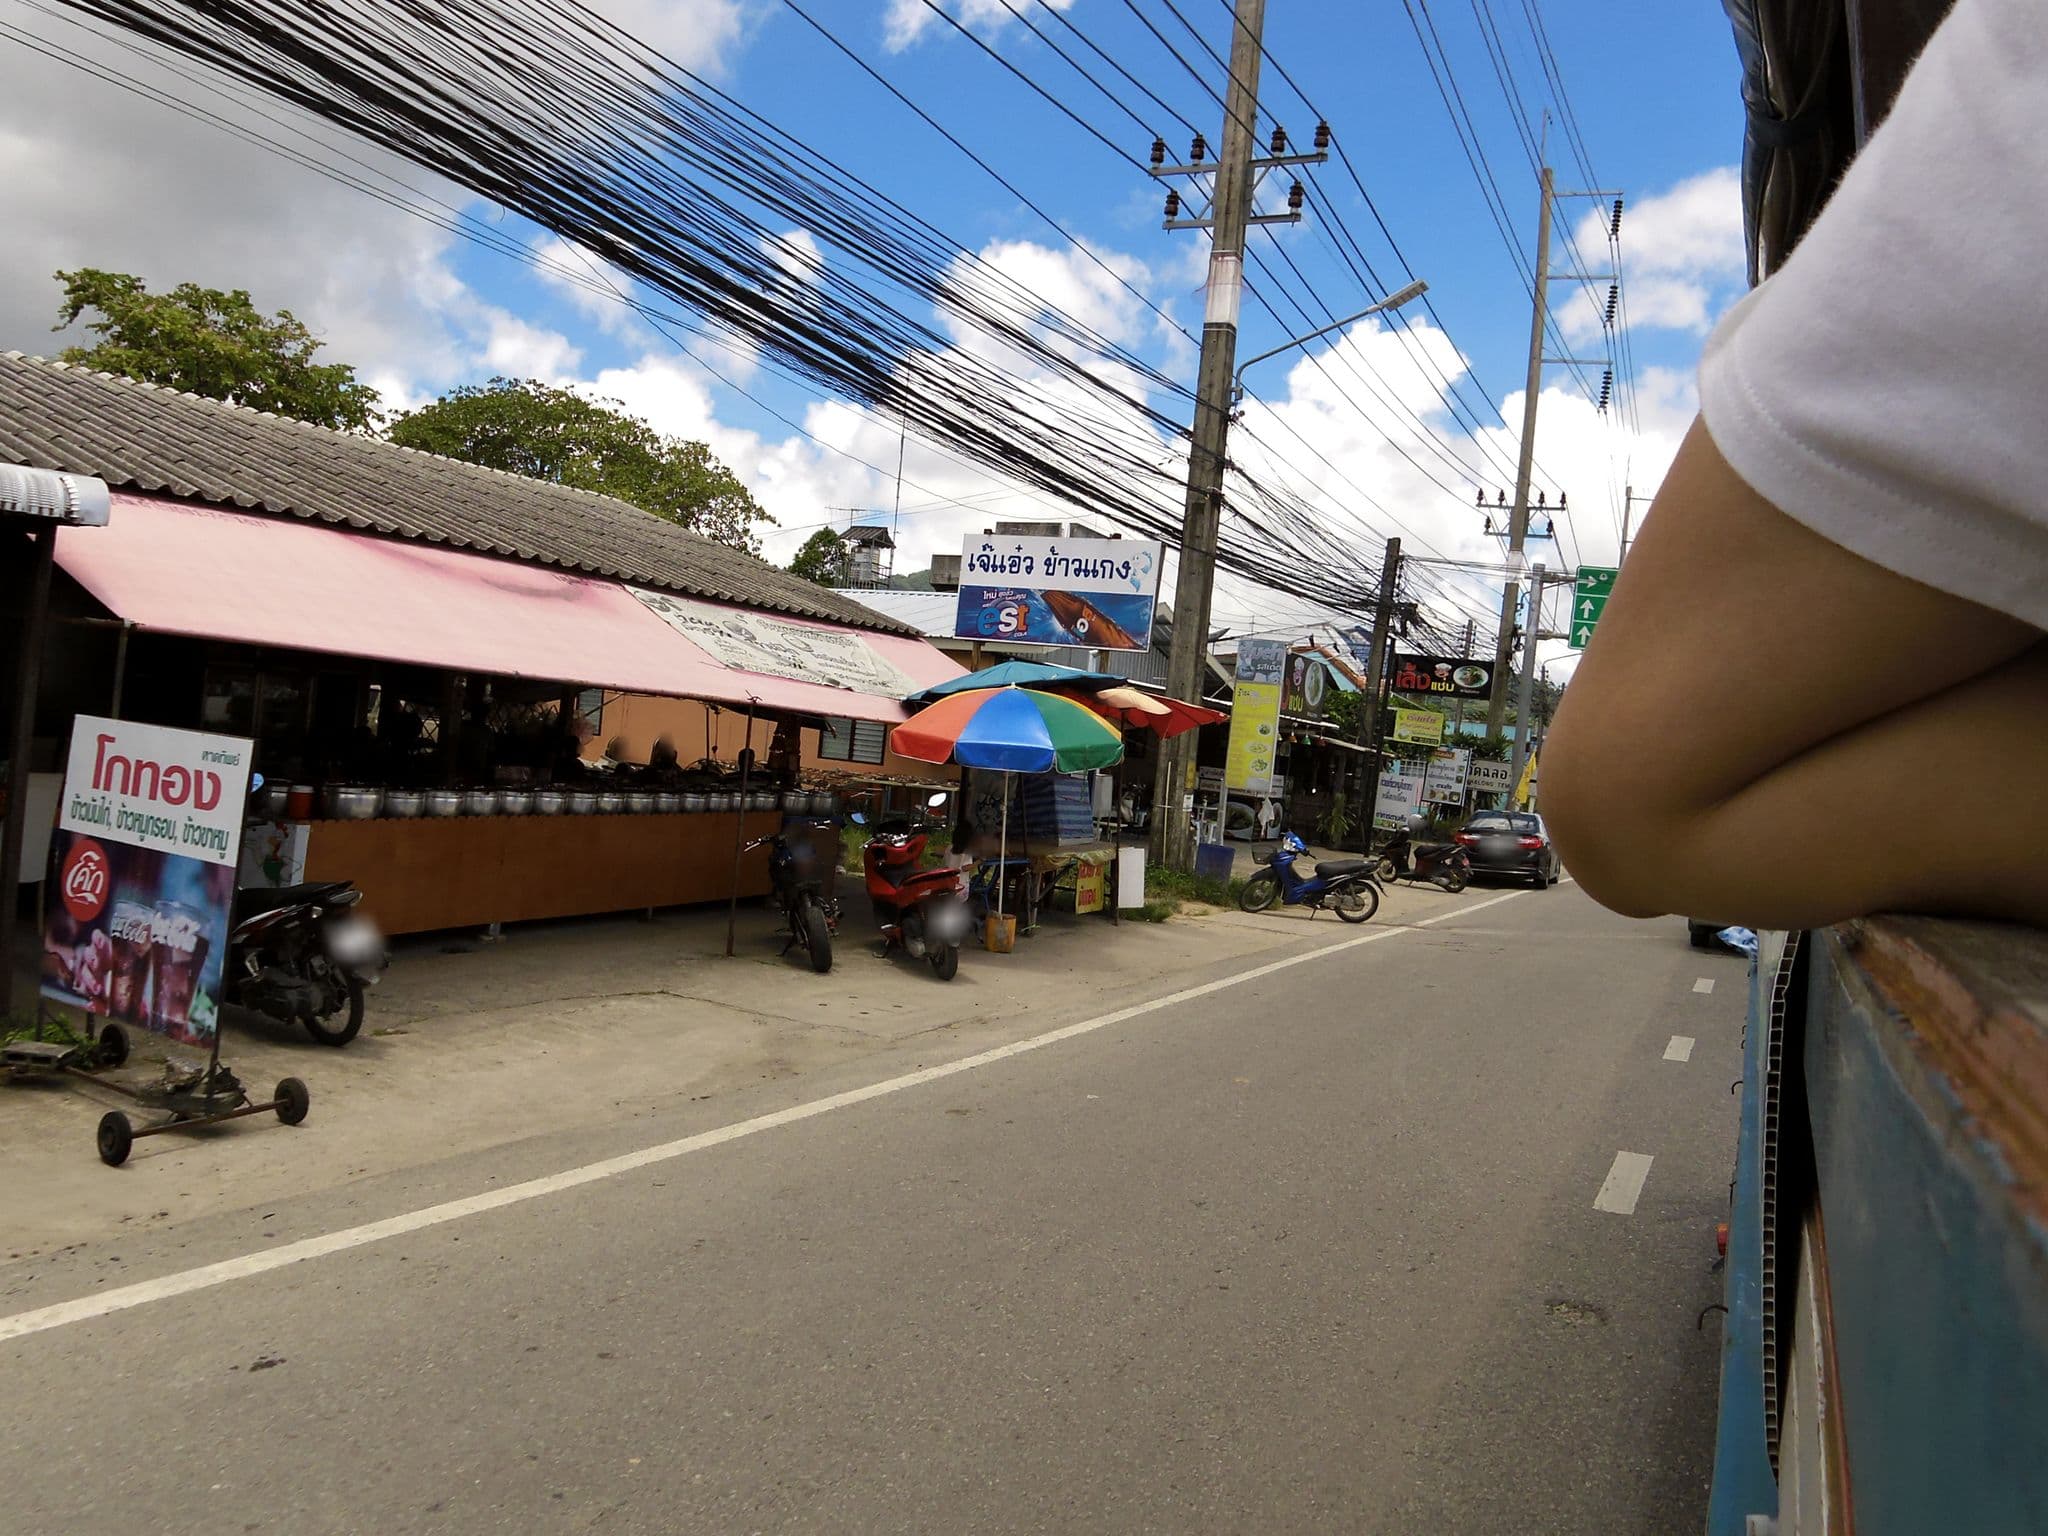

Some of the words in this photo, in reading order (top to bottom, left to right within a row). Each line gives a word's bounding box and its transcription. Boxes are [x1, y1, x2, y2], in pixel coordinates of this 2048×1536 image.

[967, 544, 1035, 575] เจ๊แอ๋ว
[1043, 545, 1131, 579] ข้าวแกง
[977, 603, 1030, 635] est
[92, 733, 222, 811] โกทอง
